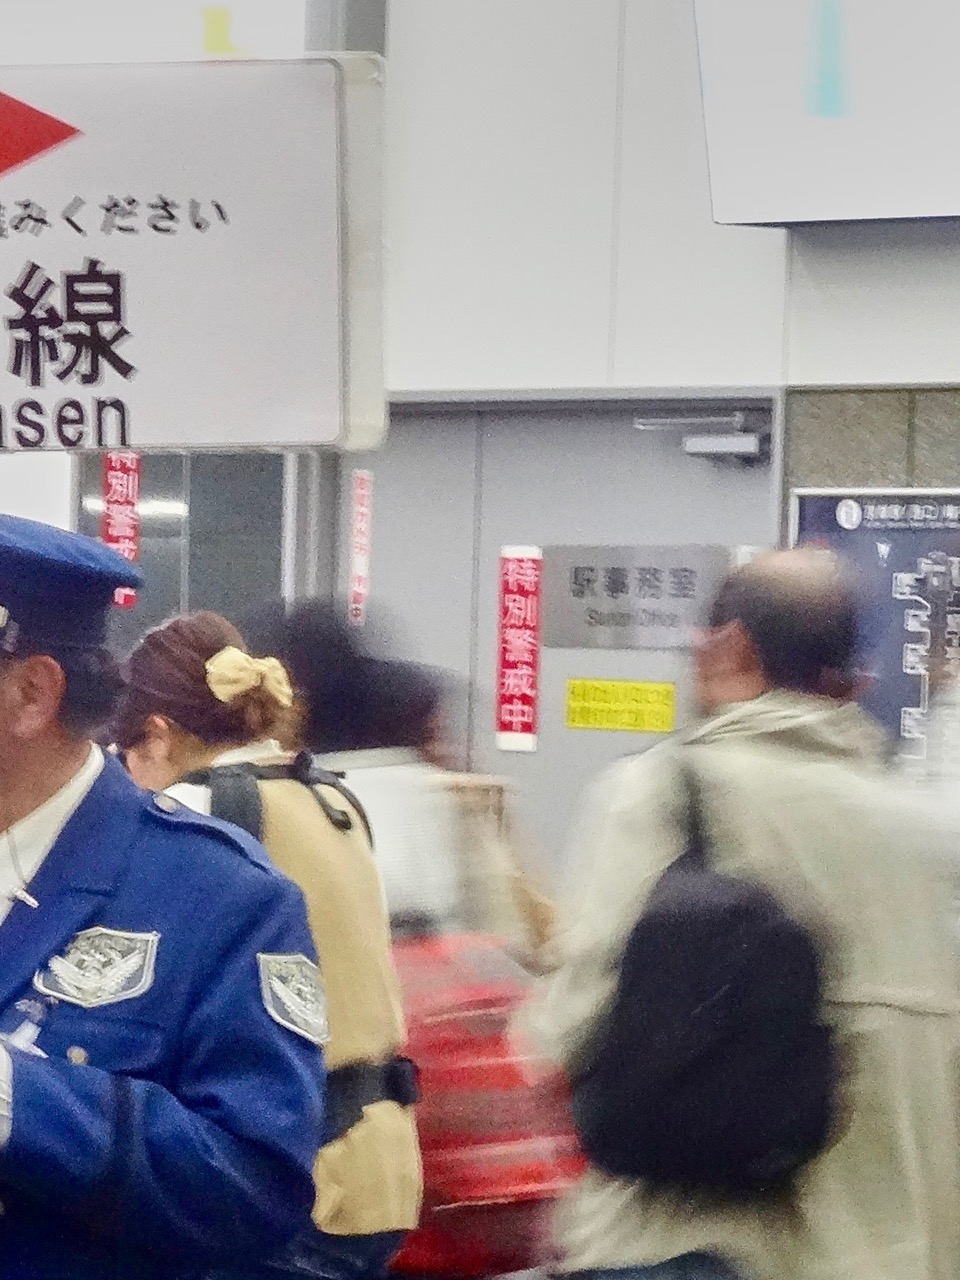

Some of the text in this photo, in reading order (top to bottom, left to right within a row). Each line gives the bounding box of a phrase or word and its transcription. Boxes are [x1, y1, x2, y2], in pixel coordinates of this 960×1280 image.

[498, 559, 540, 731] 特別警戒中
